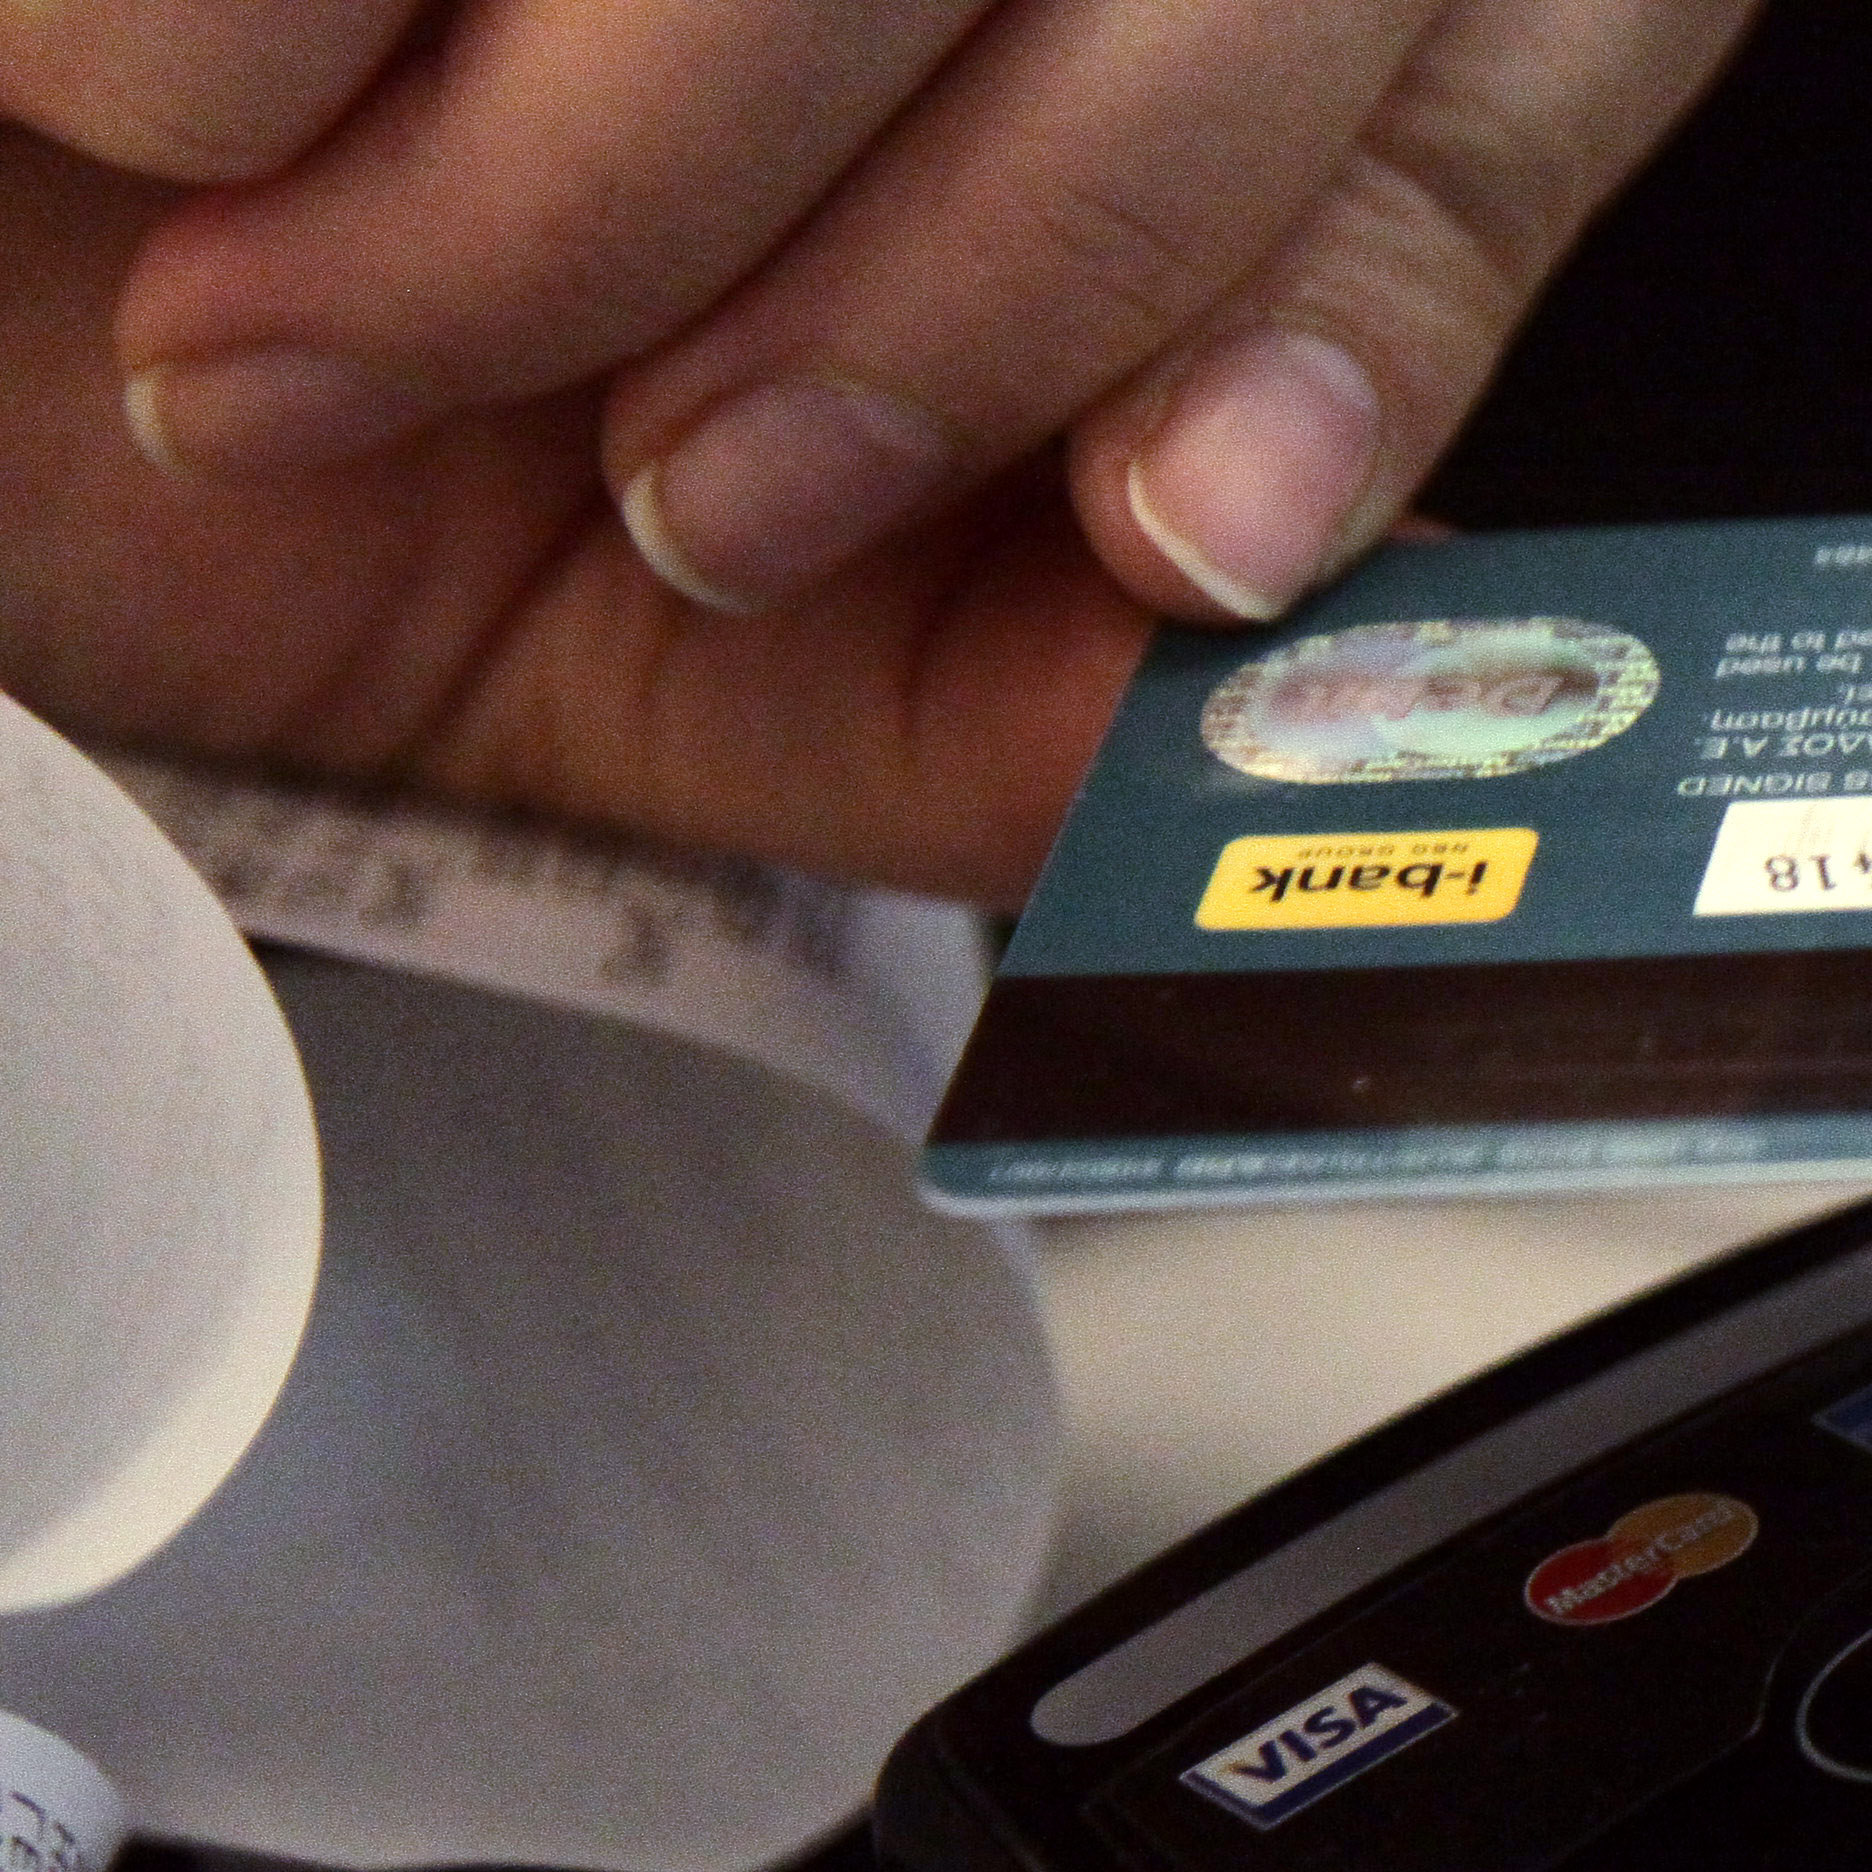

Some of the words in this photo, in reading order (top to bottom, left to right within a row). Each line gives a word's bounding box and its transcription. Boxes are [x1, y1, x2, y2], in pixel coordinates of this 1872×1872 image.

[1672, 770, 1833, 797] SIGNED
[1253, 860, 1490, 904] i-bank
[1546, 1500, 1737, 1616] MasterCard
[1227, 1684, 1410, 1781] VISA
